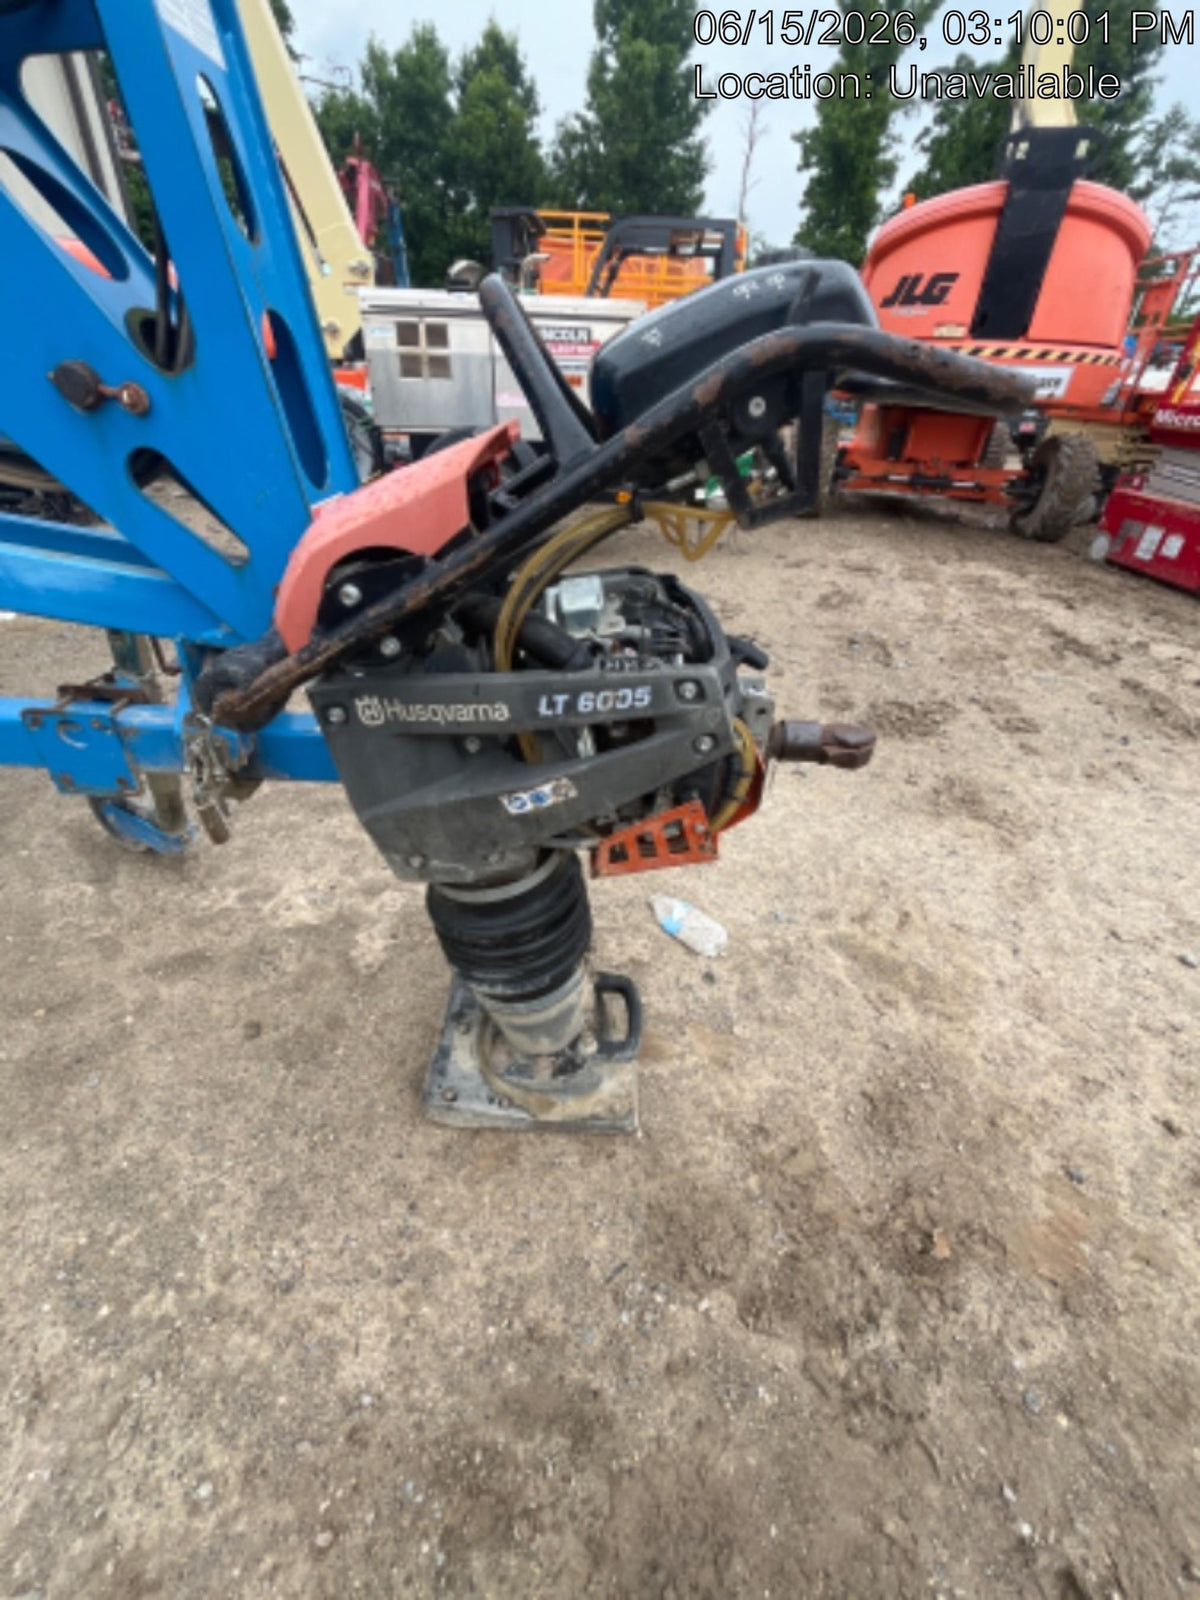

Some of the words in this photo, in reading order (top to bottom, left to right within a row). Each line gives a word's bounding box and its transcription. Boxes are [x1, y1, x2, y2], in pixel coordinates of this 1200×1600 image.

[880, 272, 959, 308] JLG
[386, 701, 509, 725] Husqvarna
[538, 695, 569, 717] LT
